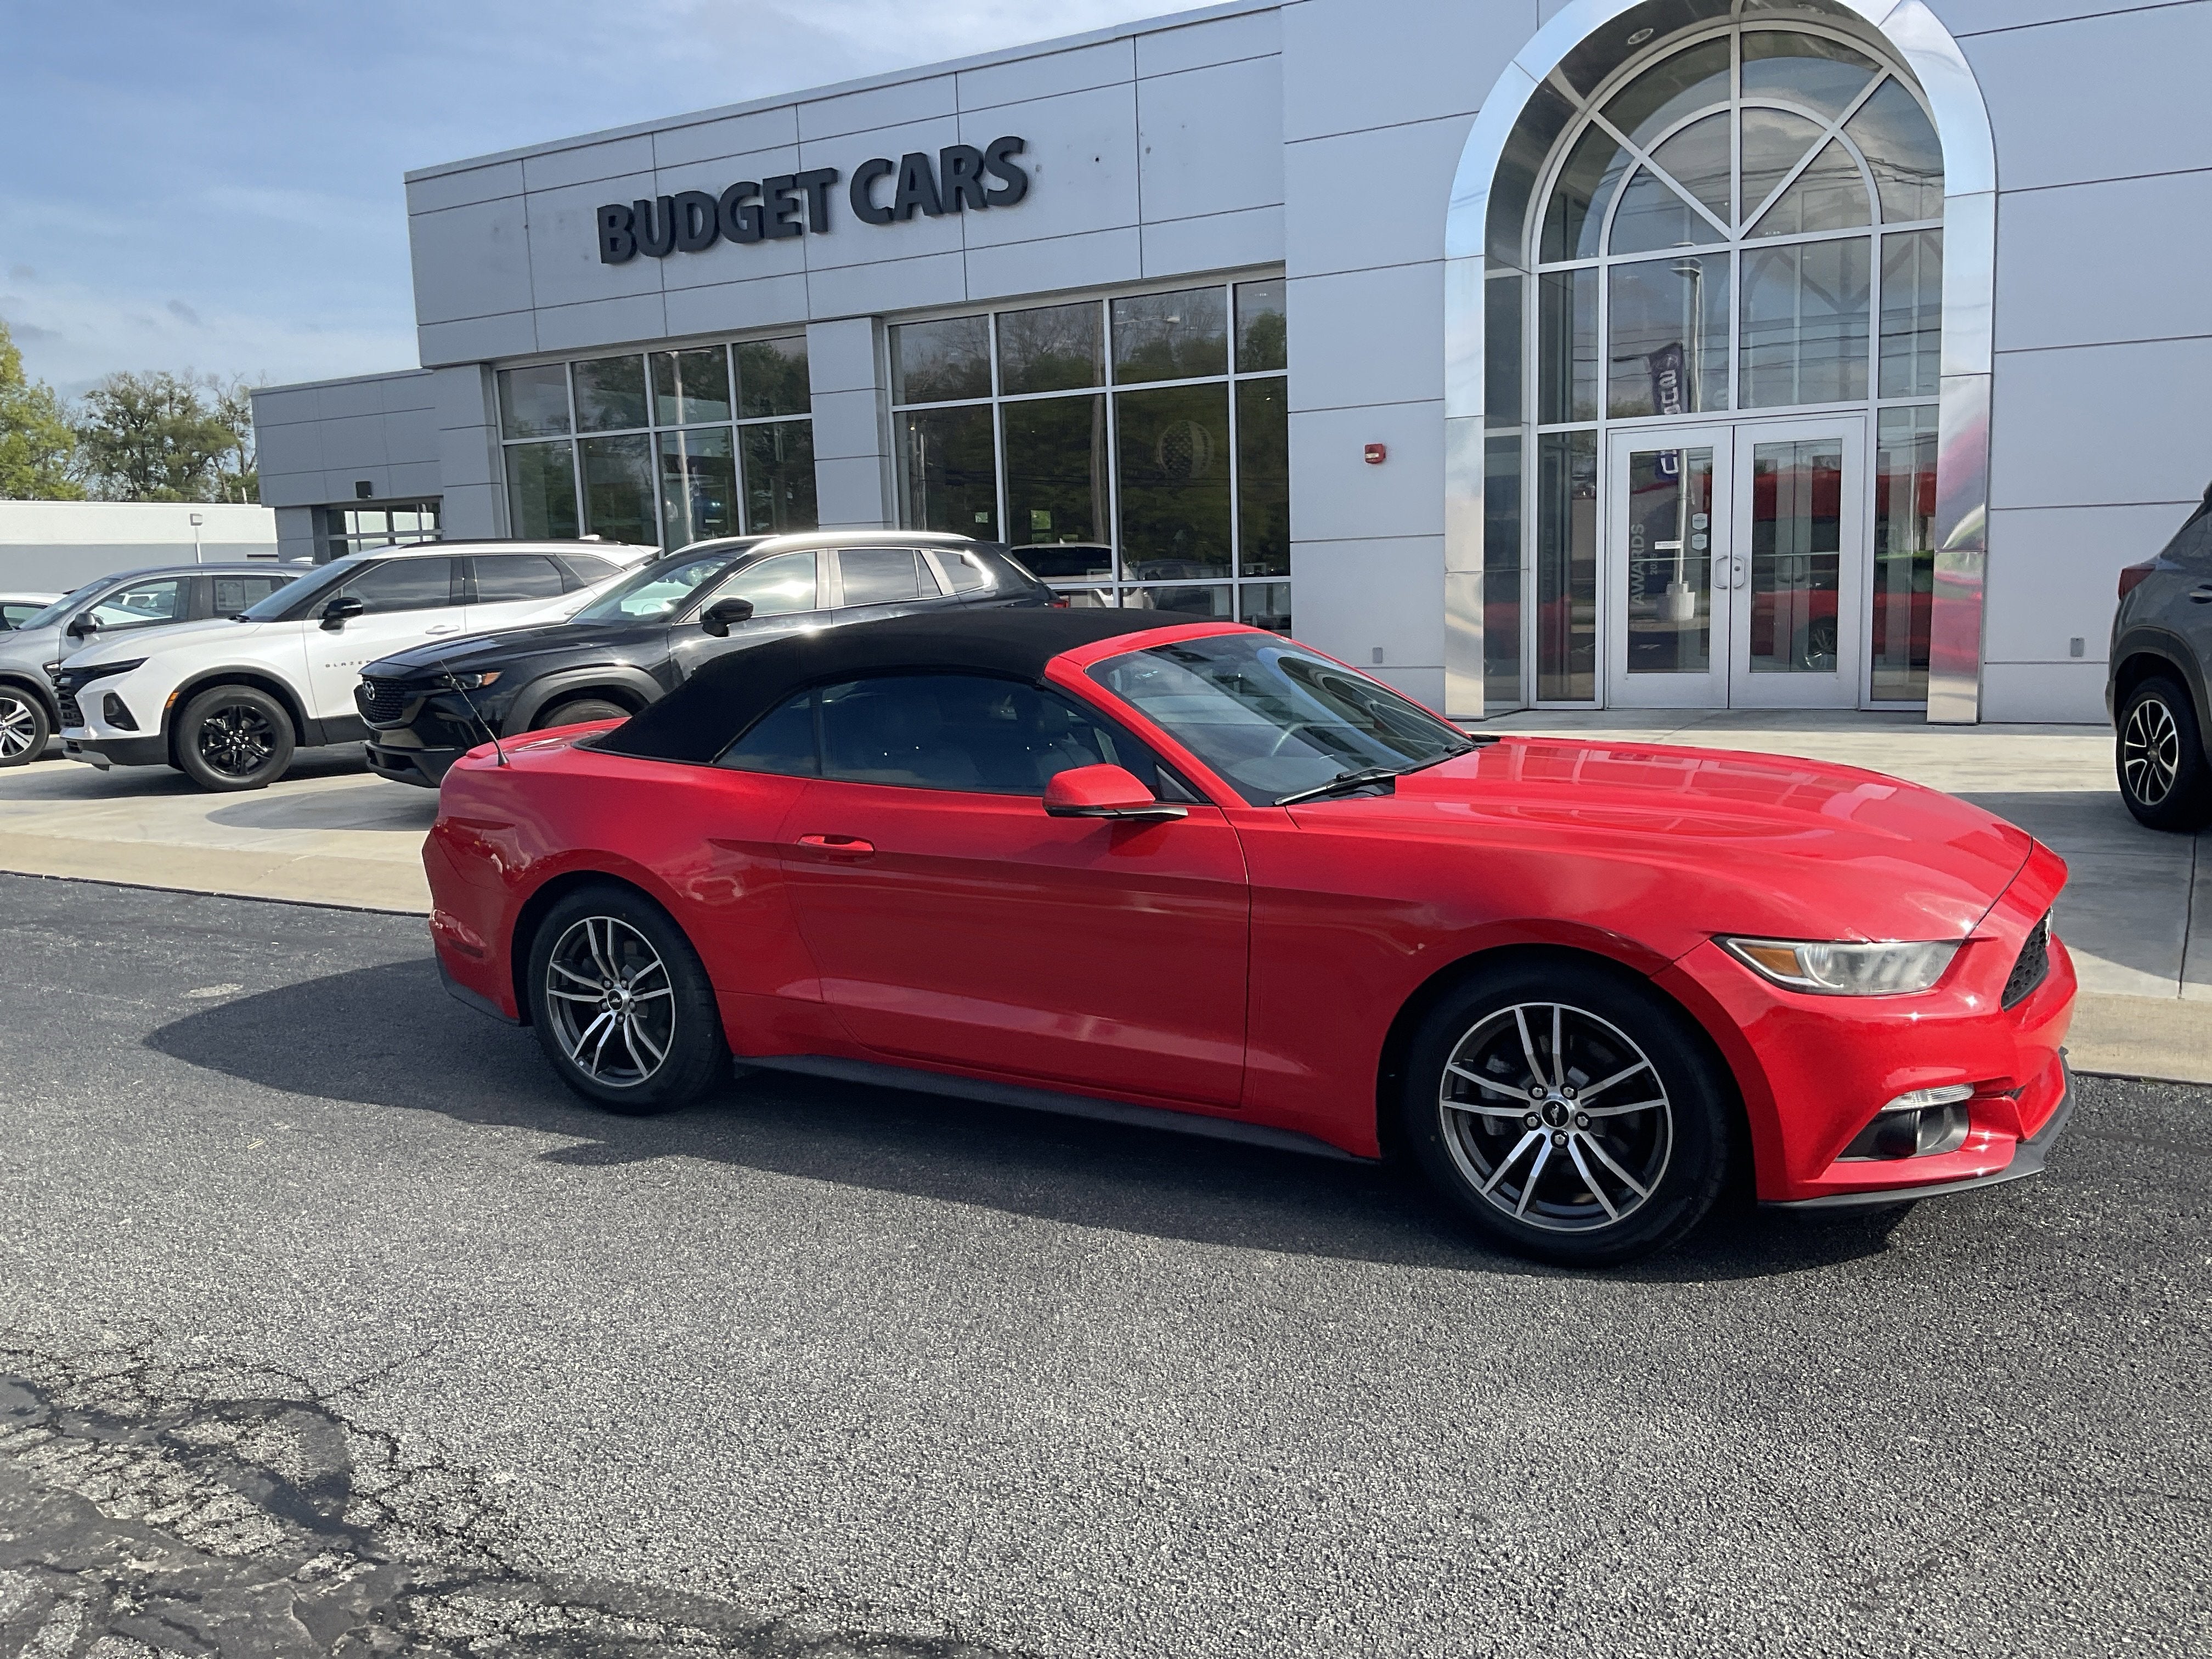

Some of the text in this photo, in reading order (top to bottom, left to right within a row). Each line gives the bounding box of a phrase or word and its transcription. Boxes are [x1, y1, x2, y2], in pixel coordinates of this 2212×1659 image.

[597, 136, 1029, 264] BUDGET CARS
[1630, 523, 1645, 605] AWARDS
